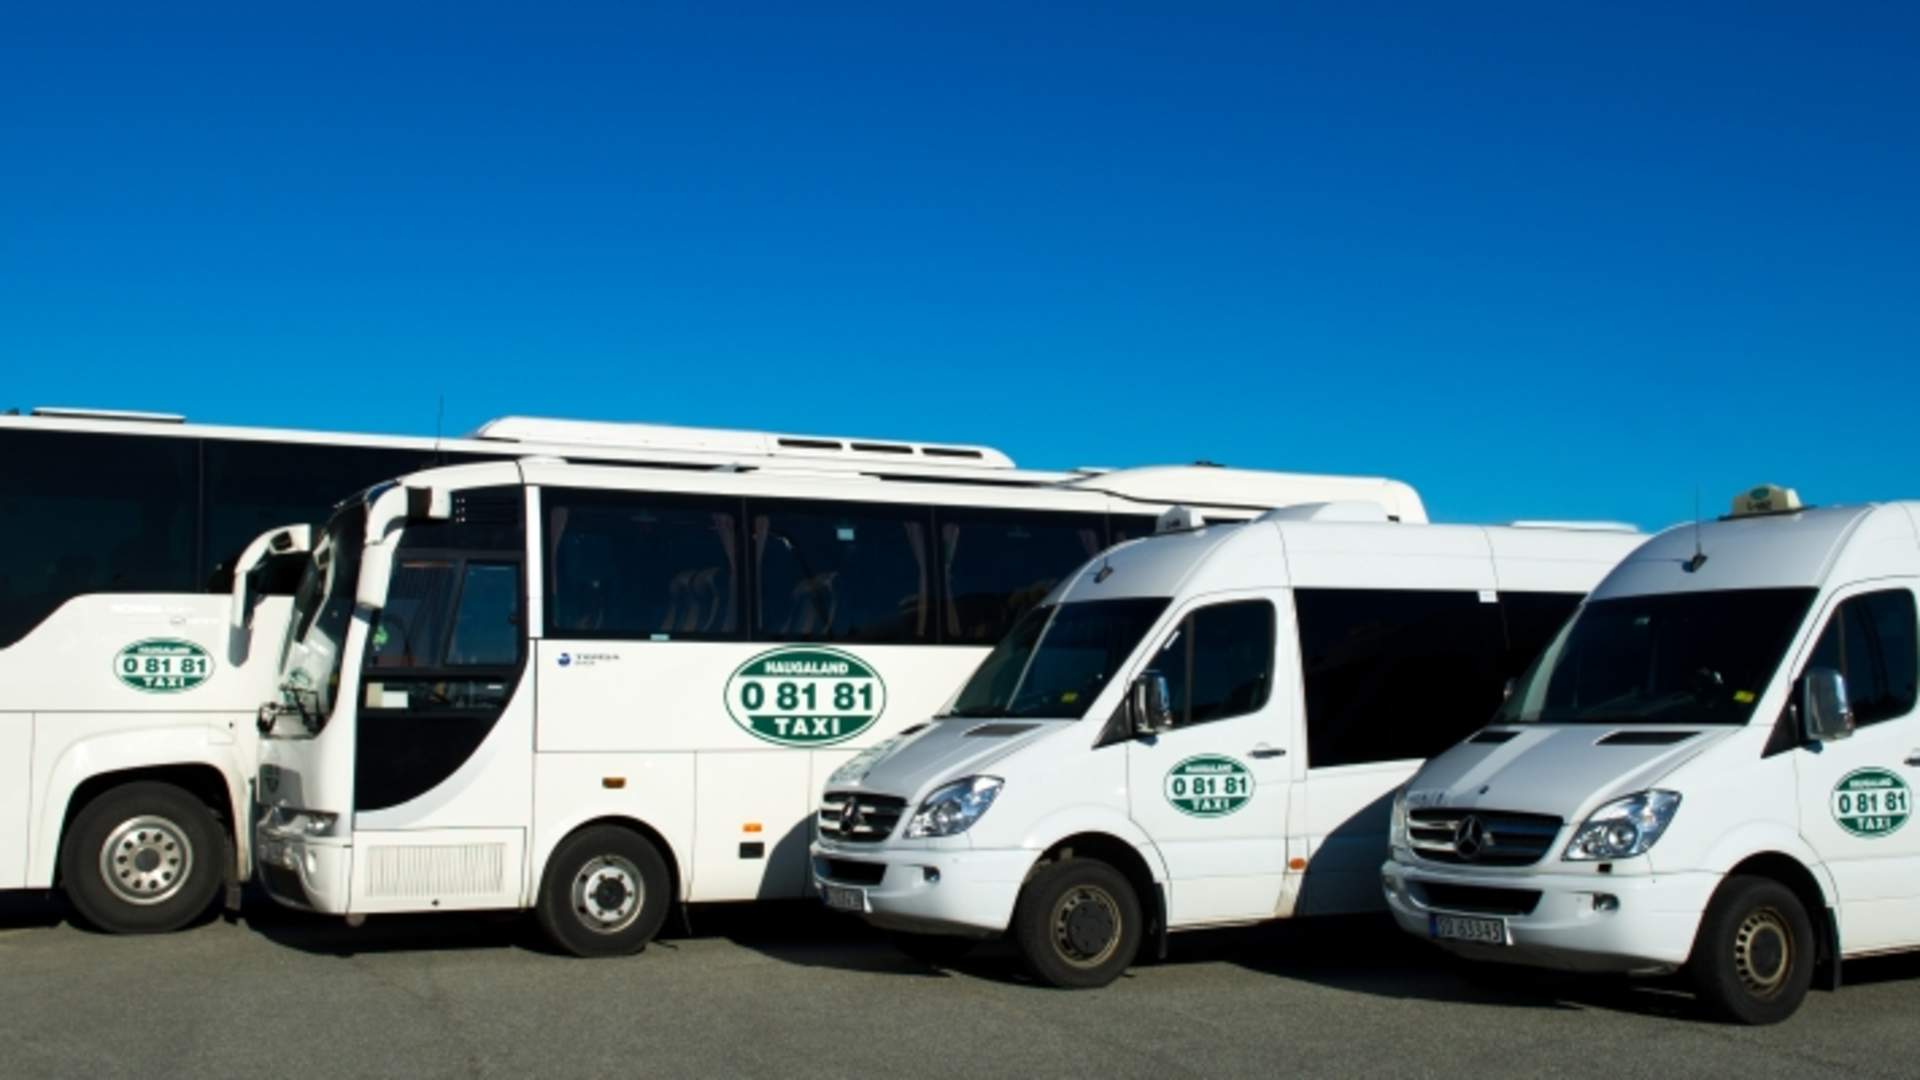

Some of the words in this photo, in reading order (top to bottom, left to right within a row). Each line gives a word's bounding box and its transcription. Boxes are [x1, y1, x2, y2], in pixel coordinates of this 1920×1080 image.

[123, 658, 138, 673] 0
[145, 658, 171, 673] 81
[180, 658, 206, 673] 81
[765, 661, 849, 674] HAUGALAND
[143, 677, 185, 687] TAXI
[741, 681, 764, 711] 0
[776, 681, 816, 711] 81
[833, 681, 873, 711] 81
[774, 718, 840, 735] TAXI
[1172, 777, 1186, 796] 0
[1193, 777, 1216, 794] 81
[1225, 776, 1246, 794] 81
[1193, 798, 1230, 811] TAXI
[1838, 793, 1851, 814] 0
[1857, 792, 1878, 813] 81
[1885, 790, 1906, 811] 81
